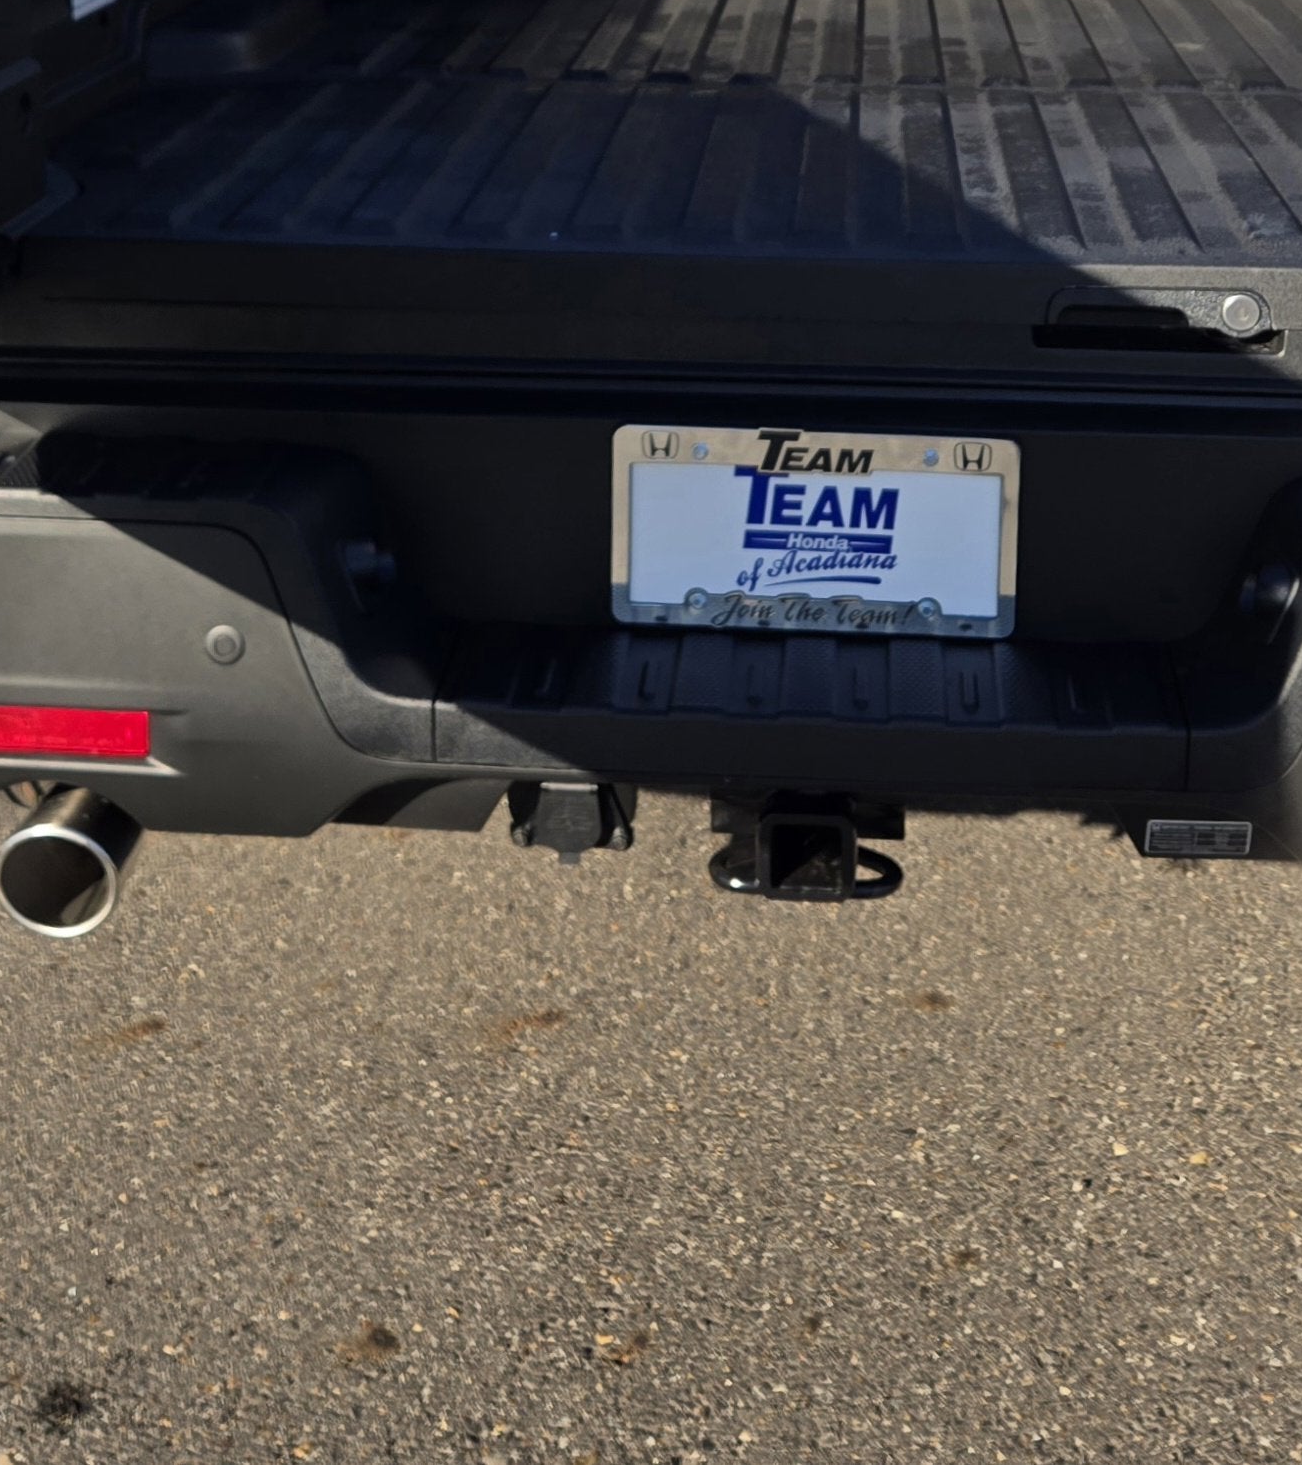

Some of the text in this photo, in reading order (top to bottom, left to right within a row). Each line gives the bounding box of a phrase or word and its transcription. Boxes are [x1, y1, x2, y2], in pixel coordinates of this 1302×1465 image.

[757, 429, 874, 474] TEAM
[734, 464, 900, 530] TEAM
[786, 532, 850, 551] Honda
[736, 548, 898, 592] of Acadiana
[710, 593, 775, 626] Join
[777, 596, 825, 623] The
